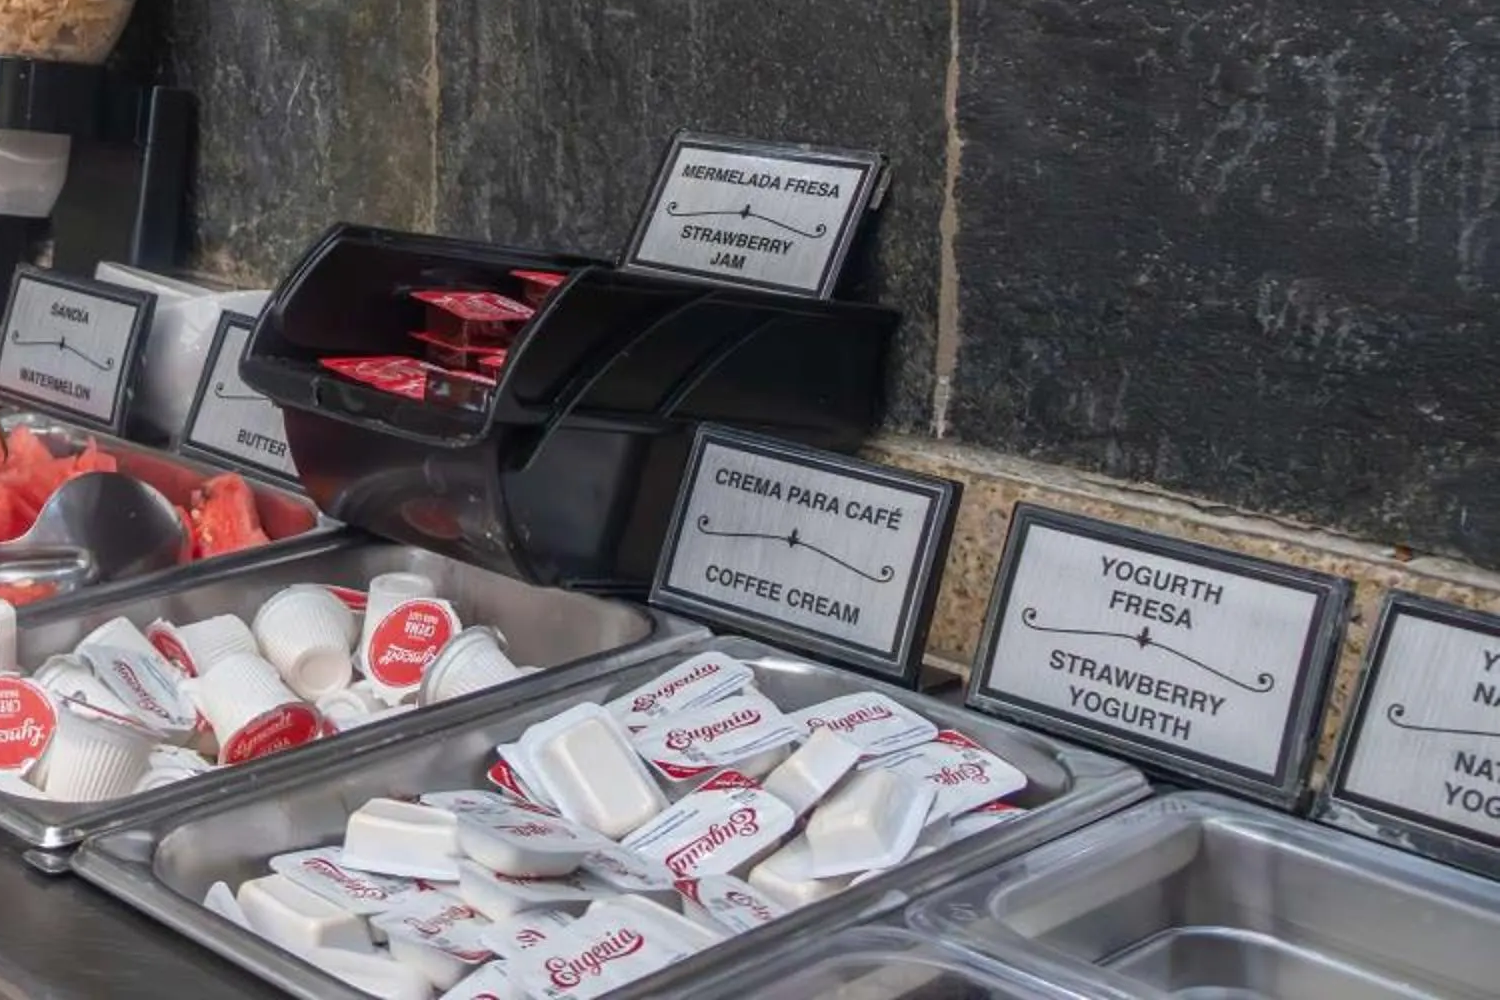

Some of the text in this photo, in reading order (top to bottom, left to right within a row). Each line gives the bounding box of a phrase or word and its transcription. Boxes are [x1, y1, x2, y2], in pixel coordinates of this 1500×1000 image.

[681, 163, 840, 198] MERMELADA FRESA
[680, 225, 793, 256] STRAWBERRY
[710, 252, 747, 270] JAM
[19, 367, 91, 401] WATERMELON
[237, 428, 288, 458] BUTTER
[715, 467, 903, 531] CREMA PARA CAFÉ
[705, 564, 861, 626] COFFEE CREAM
[1101, 555, 1224, 605] YOGURTH
[1108, 589, 1193, 629] FRESA
[631, 663, 721, 713] Eugenia
[1049, 649, 1227, 716] STRAWBERRY
[665, 709, 762, 751] Eugenia
[1069, 685, 1192, 740] YOGURTH
[924, 761, 991, 787] Euge
[665, 807, 759, 879] Eugenia
[545, 926, 645, 989] Eugenia
